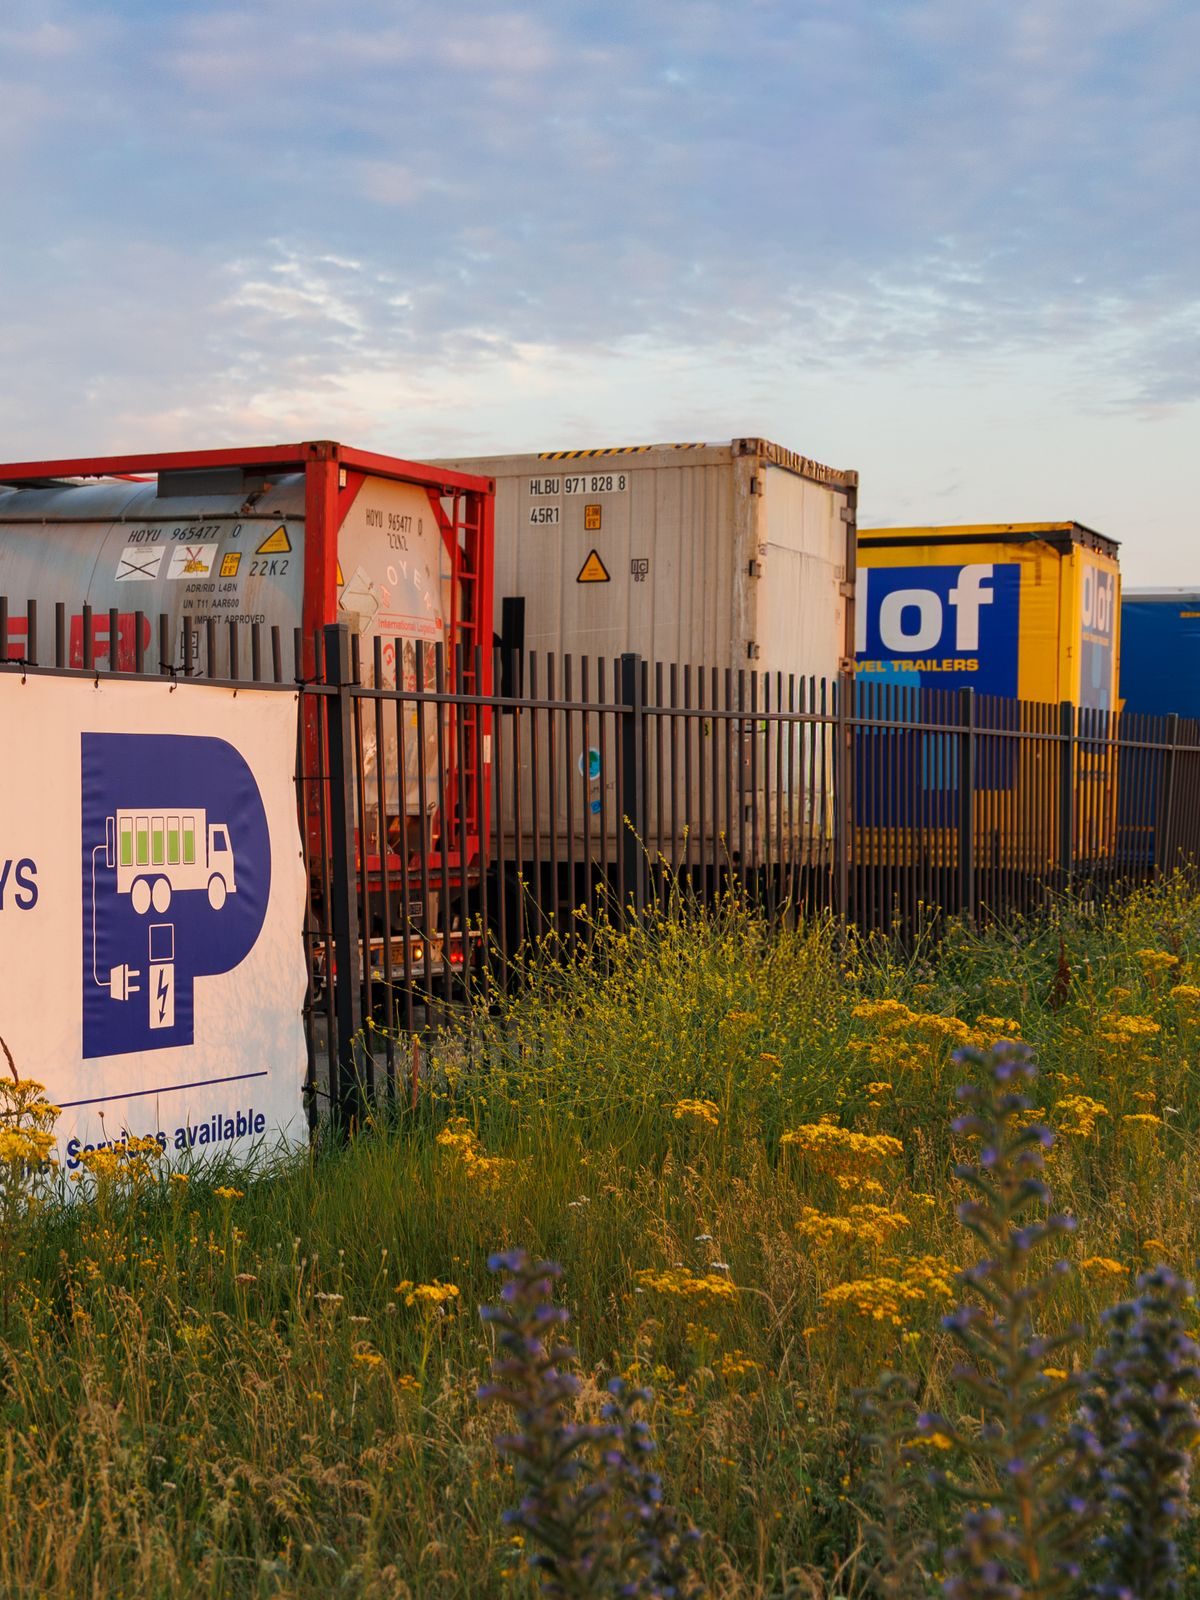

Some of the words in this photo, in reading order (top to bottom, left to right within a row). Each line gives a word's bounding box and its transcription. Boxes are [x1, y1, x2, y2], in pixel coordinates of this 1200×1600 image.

[530, 479, 560, 495] HLBU
[565, 478, 586, 493] 971
[591, 476, 613, 492] 828
[618, 475, 626, 491] 8
[365, 508, 383, 528] HOYU
[388, 513, 412, 533] 965477
[530, 507, 560, 523] 45R1
[128, 529, 162, 543] HOYU
[170, 526, 220, 541] 965477
[249, 559, 290, 577] 22K2
[185, 583, 216, 593] ADR/RID
[218, 583, 238, 592] L4BN
[183, 599, 193, 609] UN
[197, 599, 208, 609] T11
[211, 599, 240, 608] AAR600
[224, 614, 266, 625] APPROVED
[891, 658, 980, 672] TRAILERS
[174, 1108, 266, 1151] available
